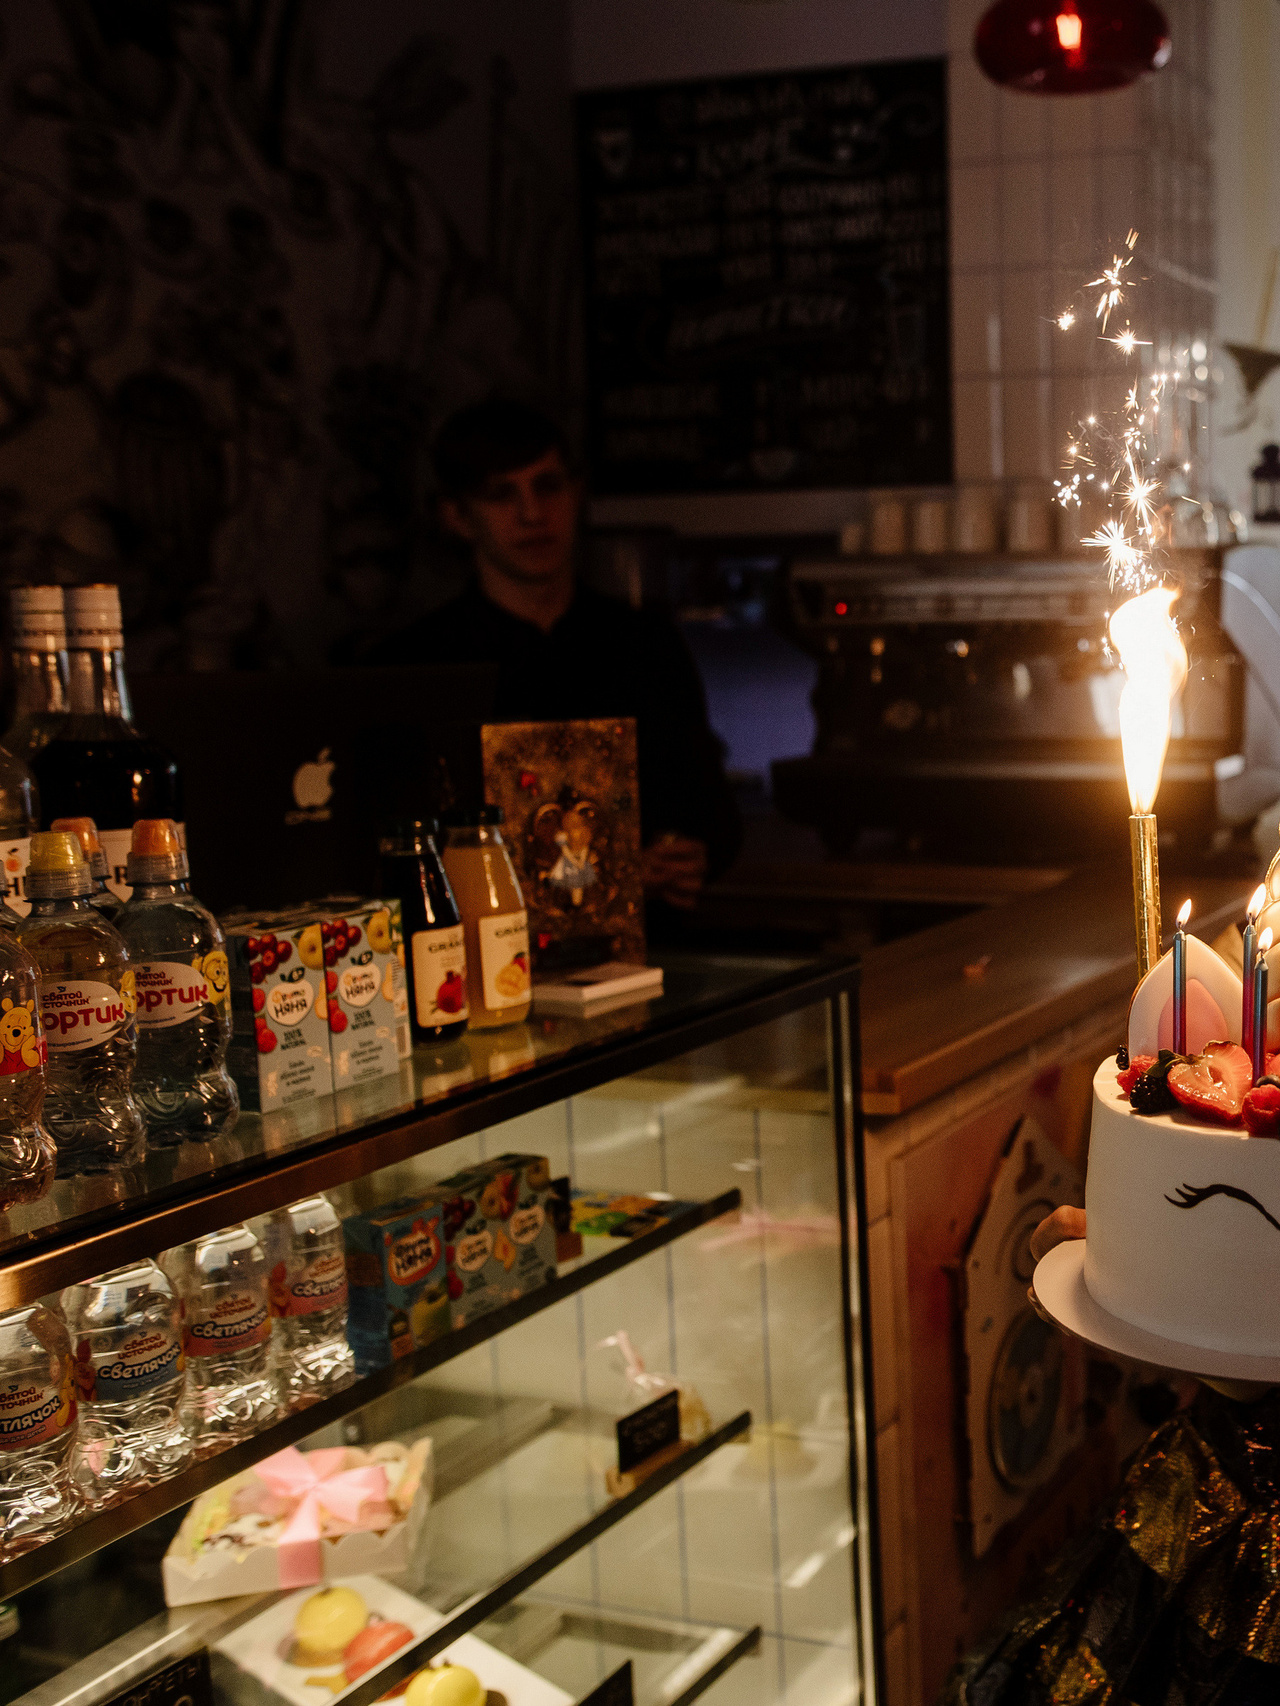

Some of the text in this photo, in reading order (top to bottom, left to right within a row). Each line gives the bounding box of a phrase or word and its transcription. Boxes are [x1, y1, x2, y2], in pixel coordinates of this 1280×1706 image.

[136, 971, 166, 980] вятой
[136, 978, 173, 987] точник
[43, 997, 89, 1009] сточник
[136, 984, 208, 1013] ортик
[43, 1003, 125, 1035] ортик
[0, 1386, 36, 1402] вятой
[0, 1392, 44, 1411] точник
[0, 1397, 61, 1433] тлячок
